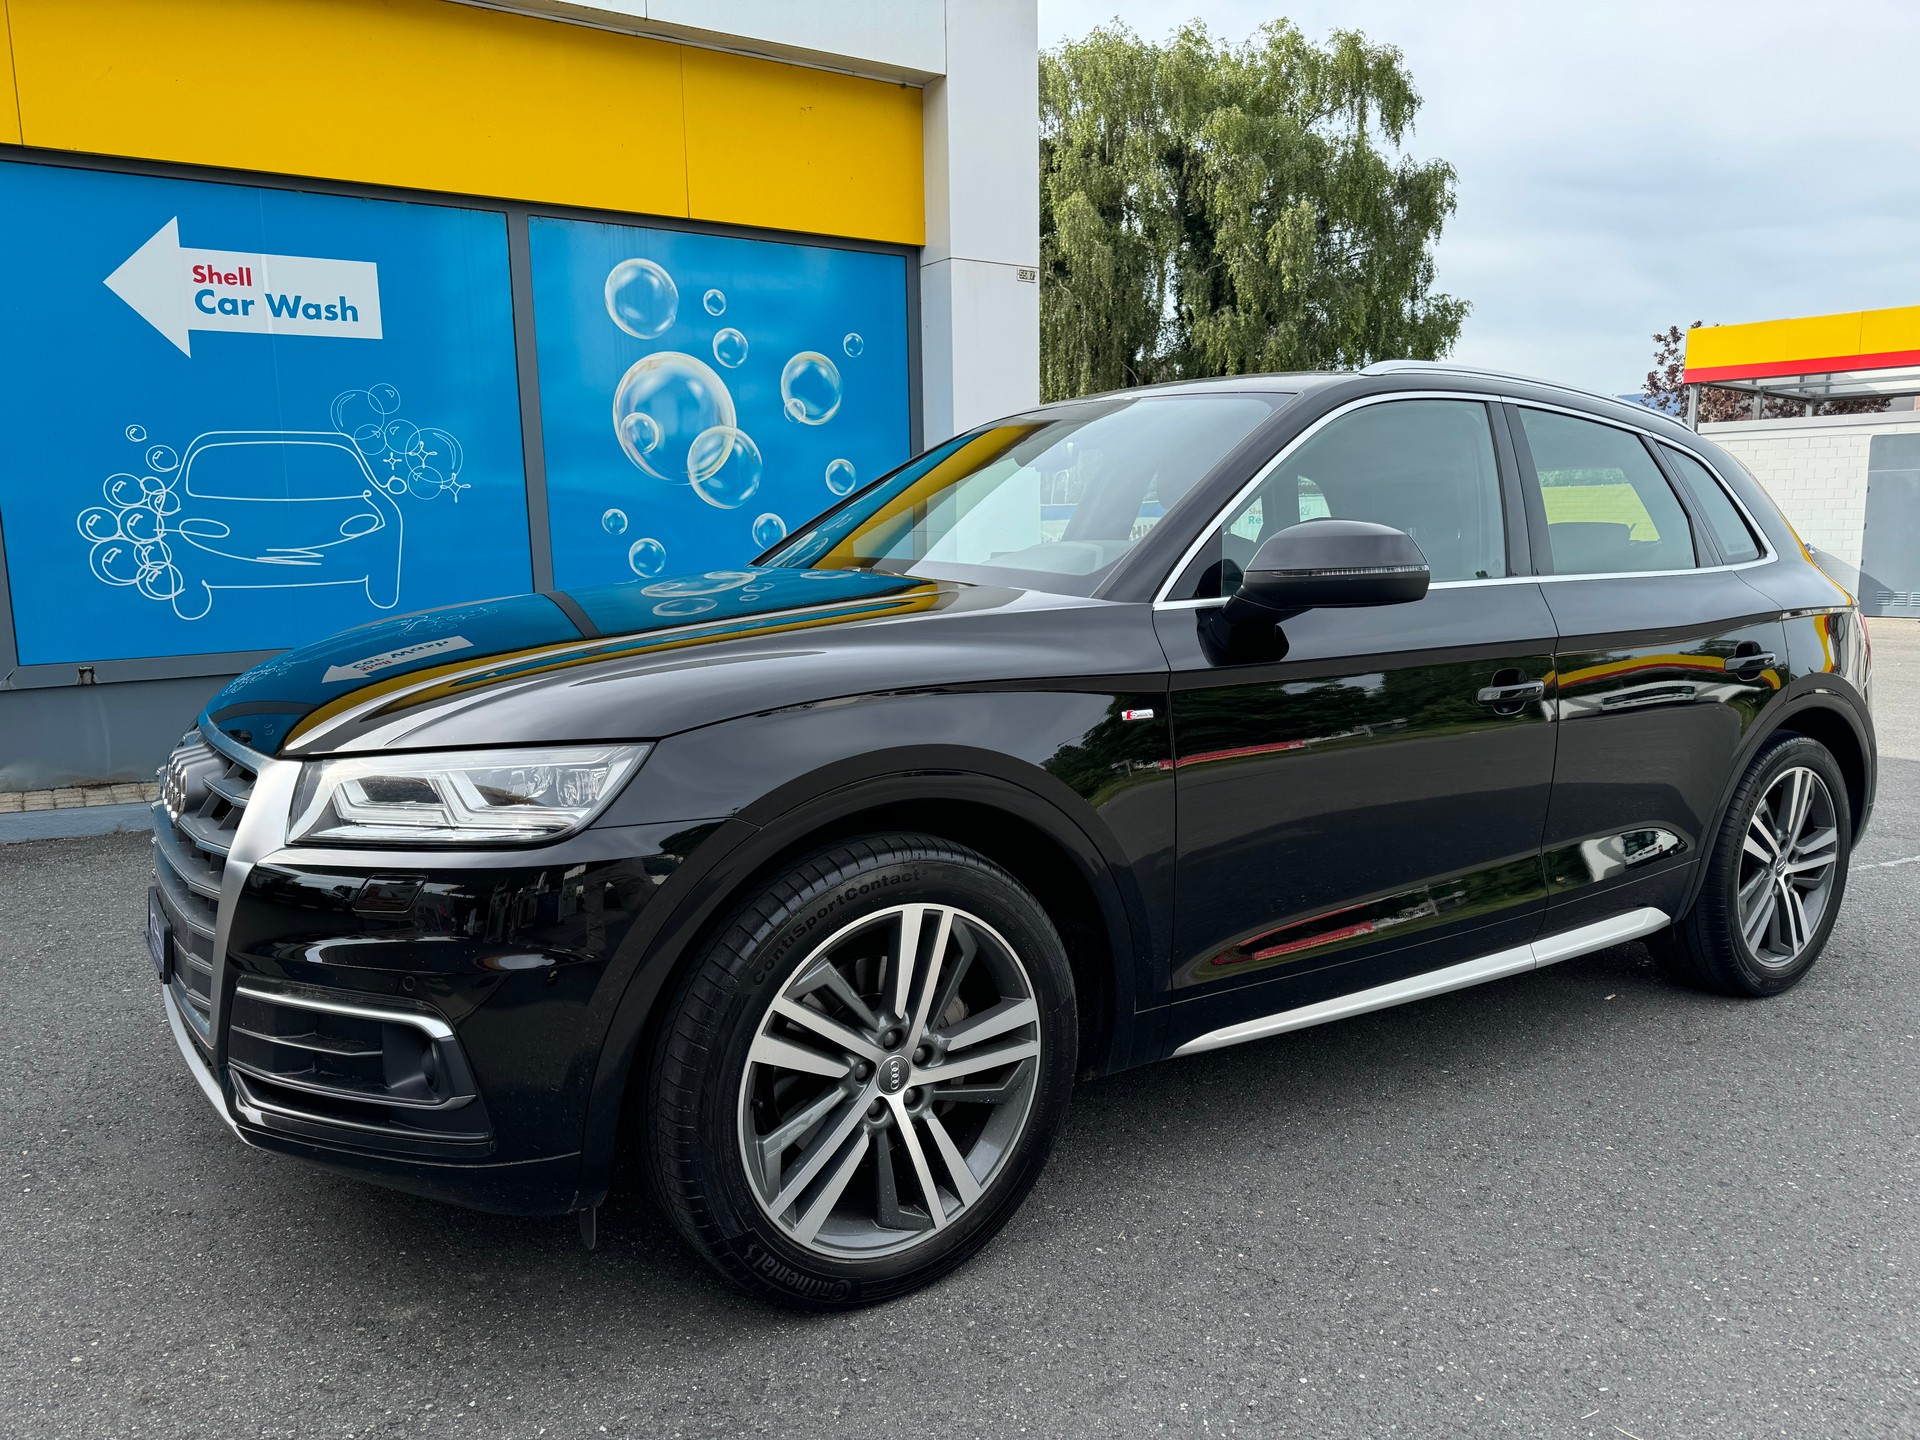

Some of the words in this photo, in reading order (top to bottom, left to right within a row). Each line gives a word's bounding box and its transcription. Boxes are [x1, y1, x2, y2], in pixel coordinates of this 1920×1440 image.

[192, 264, 252, 287] Shell
[194, 289, 255, 316] Car
[264, 293, 359, 322] Wash
[752, 1252, 852, 1300] Continental
